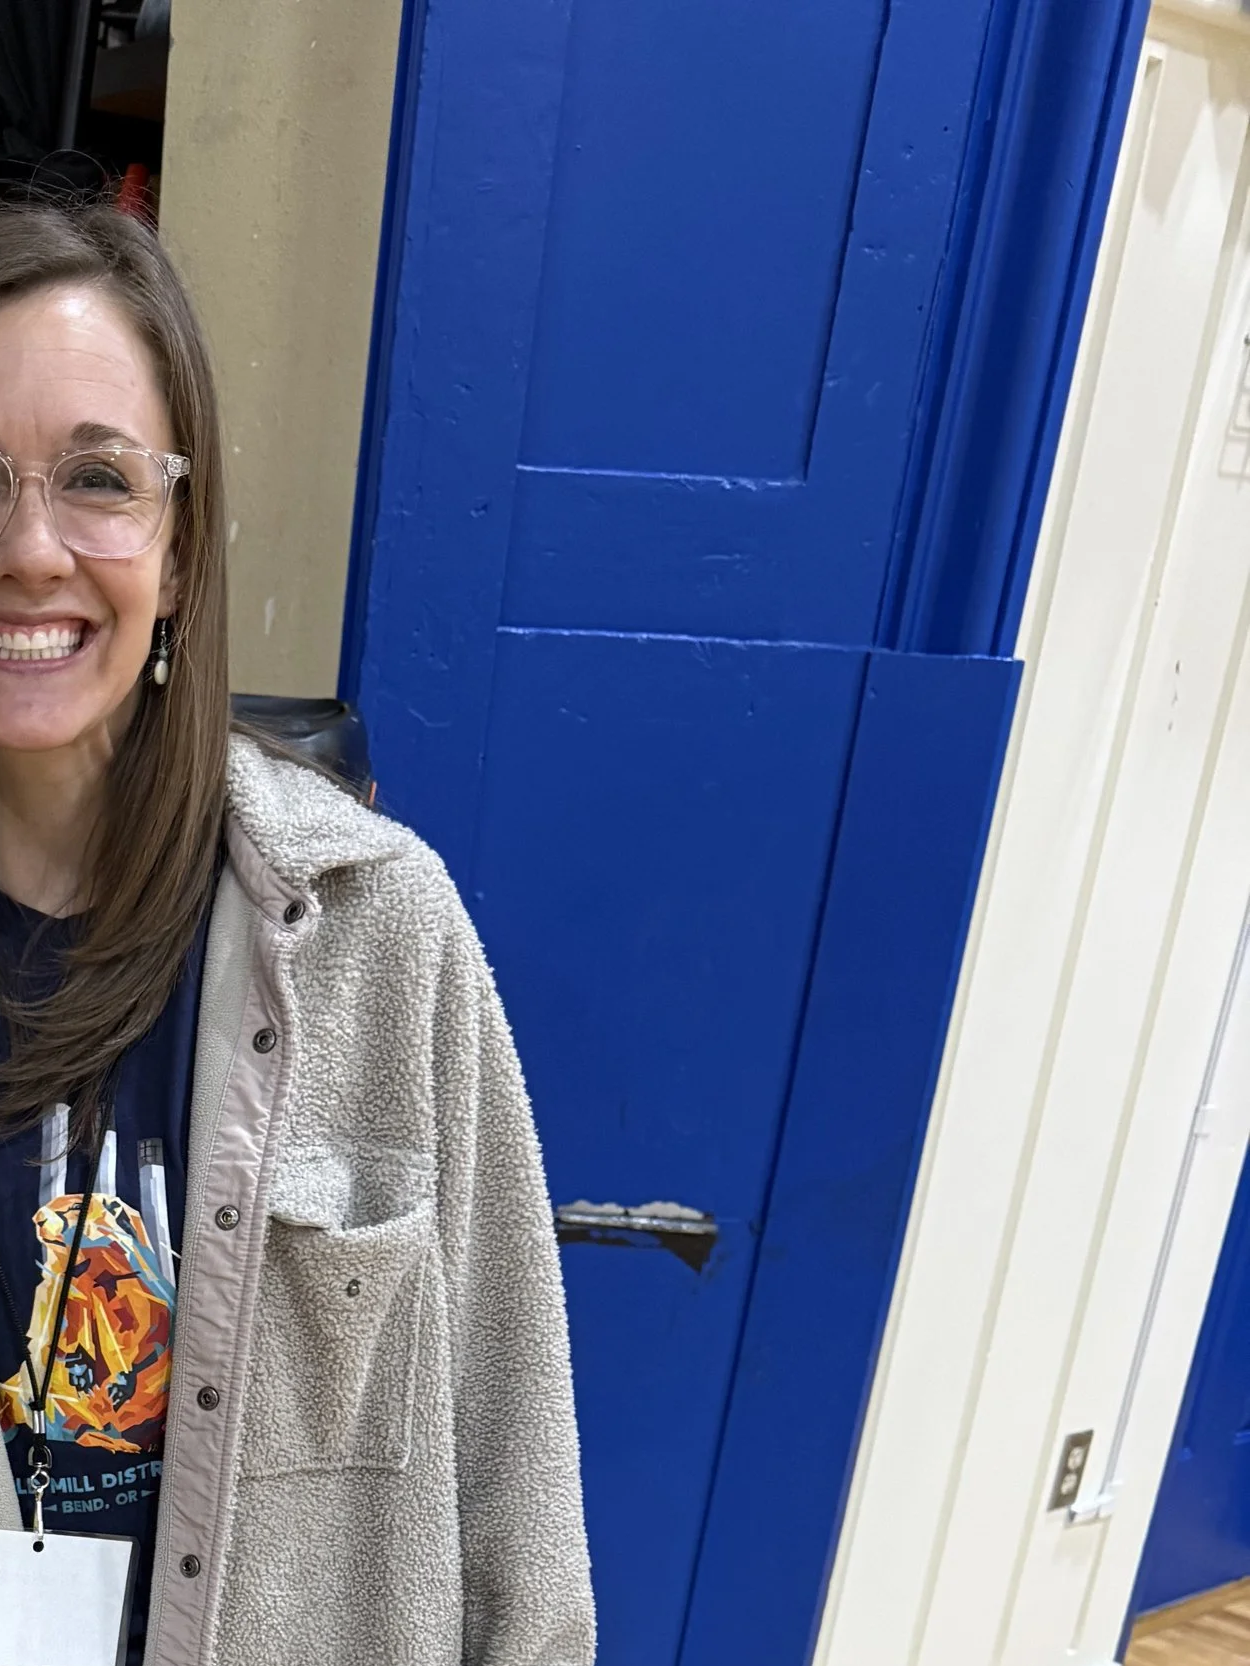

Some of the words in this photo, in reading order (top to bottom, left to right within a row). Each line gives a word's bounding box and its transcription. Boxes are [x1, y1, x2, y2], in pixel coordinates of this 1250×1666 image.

[51, 1475, 95, 1494] MILL
[101, 1460, 163, 1489] DISTR
[115, 1490, 138, 1506] OR
